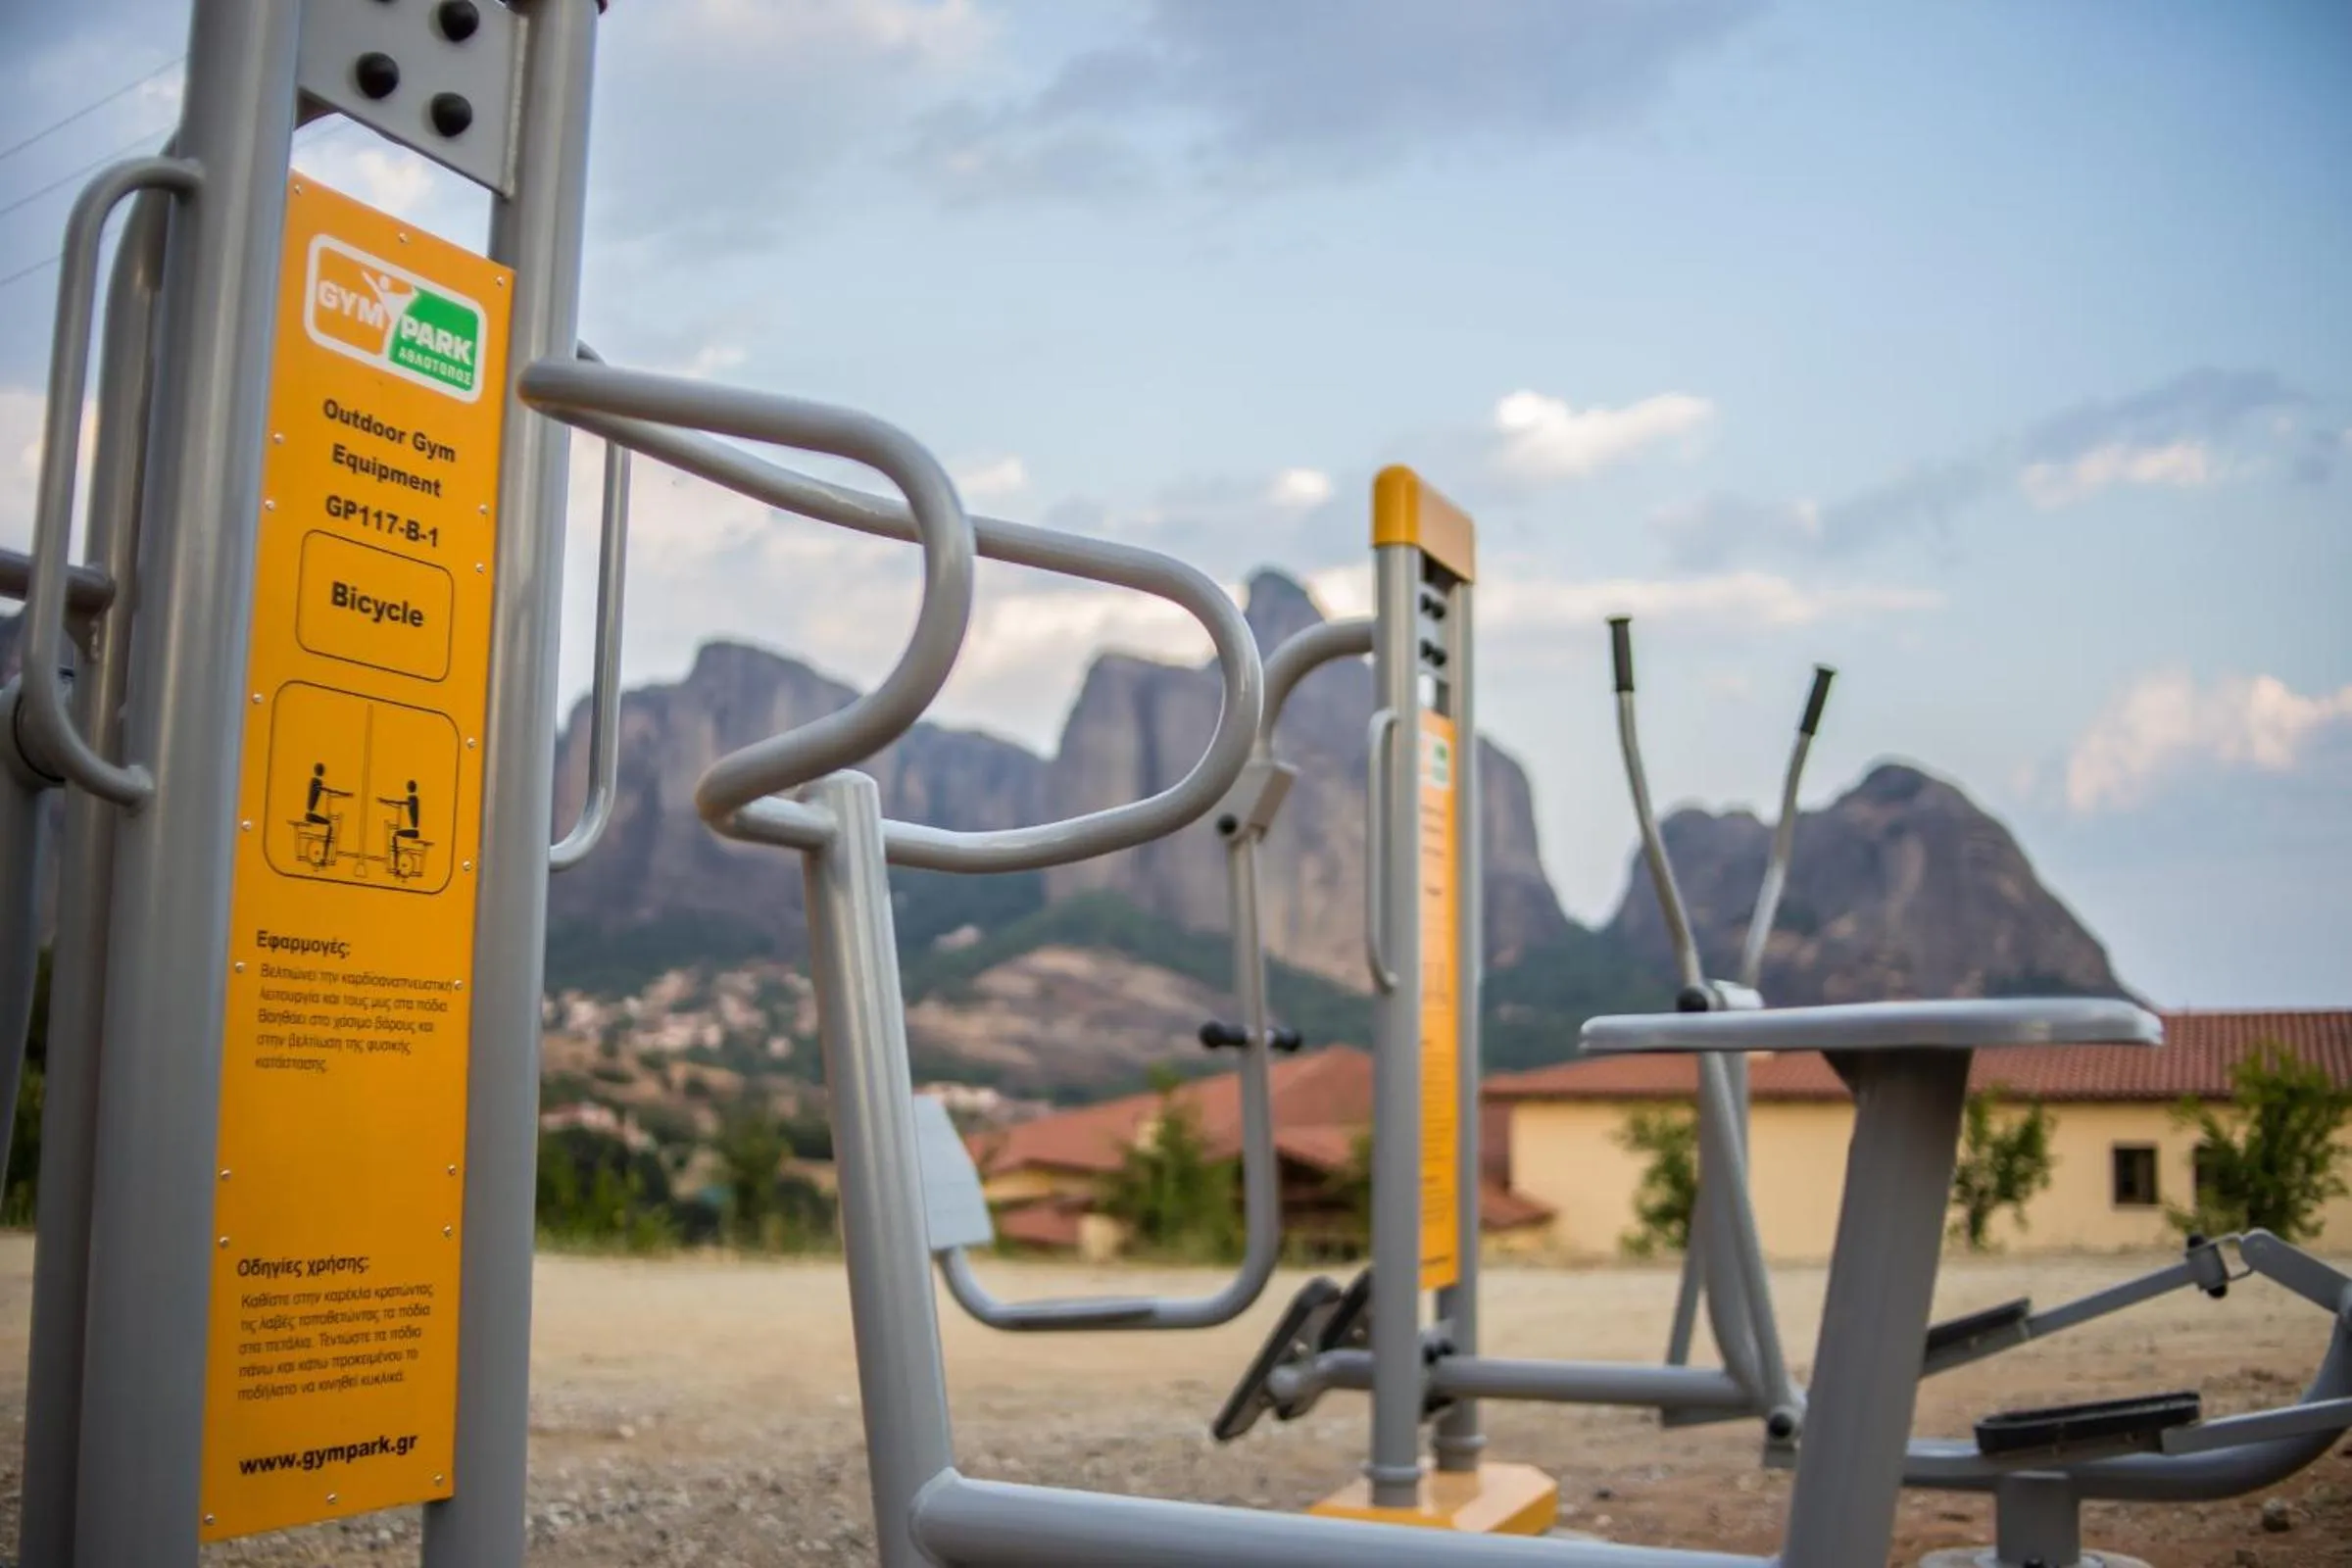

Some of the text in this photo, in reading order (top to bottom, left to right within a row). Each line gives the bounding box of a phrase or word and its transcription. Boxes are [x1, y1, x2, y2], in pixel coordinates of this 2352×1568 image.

[318, 279, 473, 365] GYM PARK
[322, 398, 457, 463] Outdoor Gym
[331, 443, 442, 498] Equipment
[325, 495, 439, 548] GP117-B-1
[330, 580, 423, 627] Bicycle
[237, 1257, 302, 1279] Οδηγίες
[239, 1434, 418, 1476] www.gympark.gr
